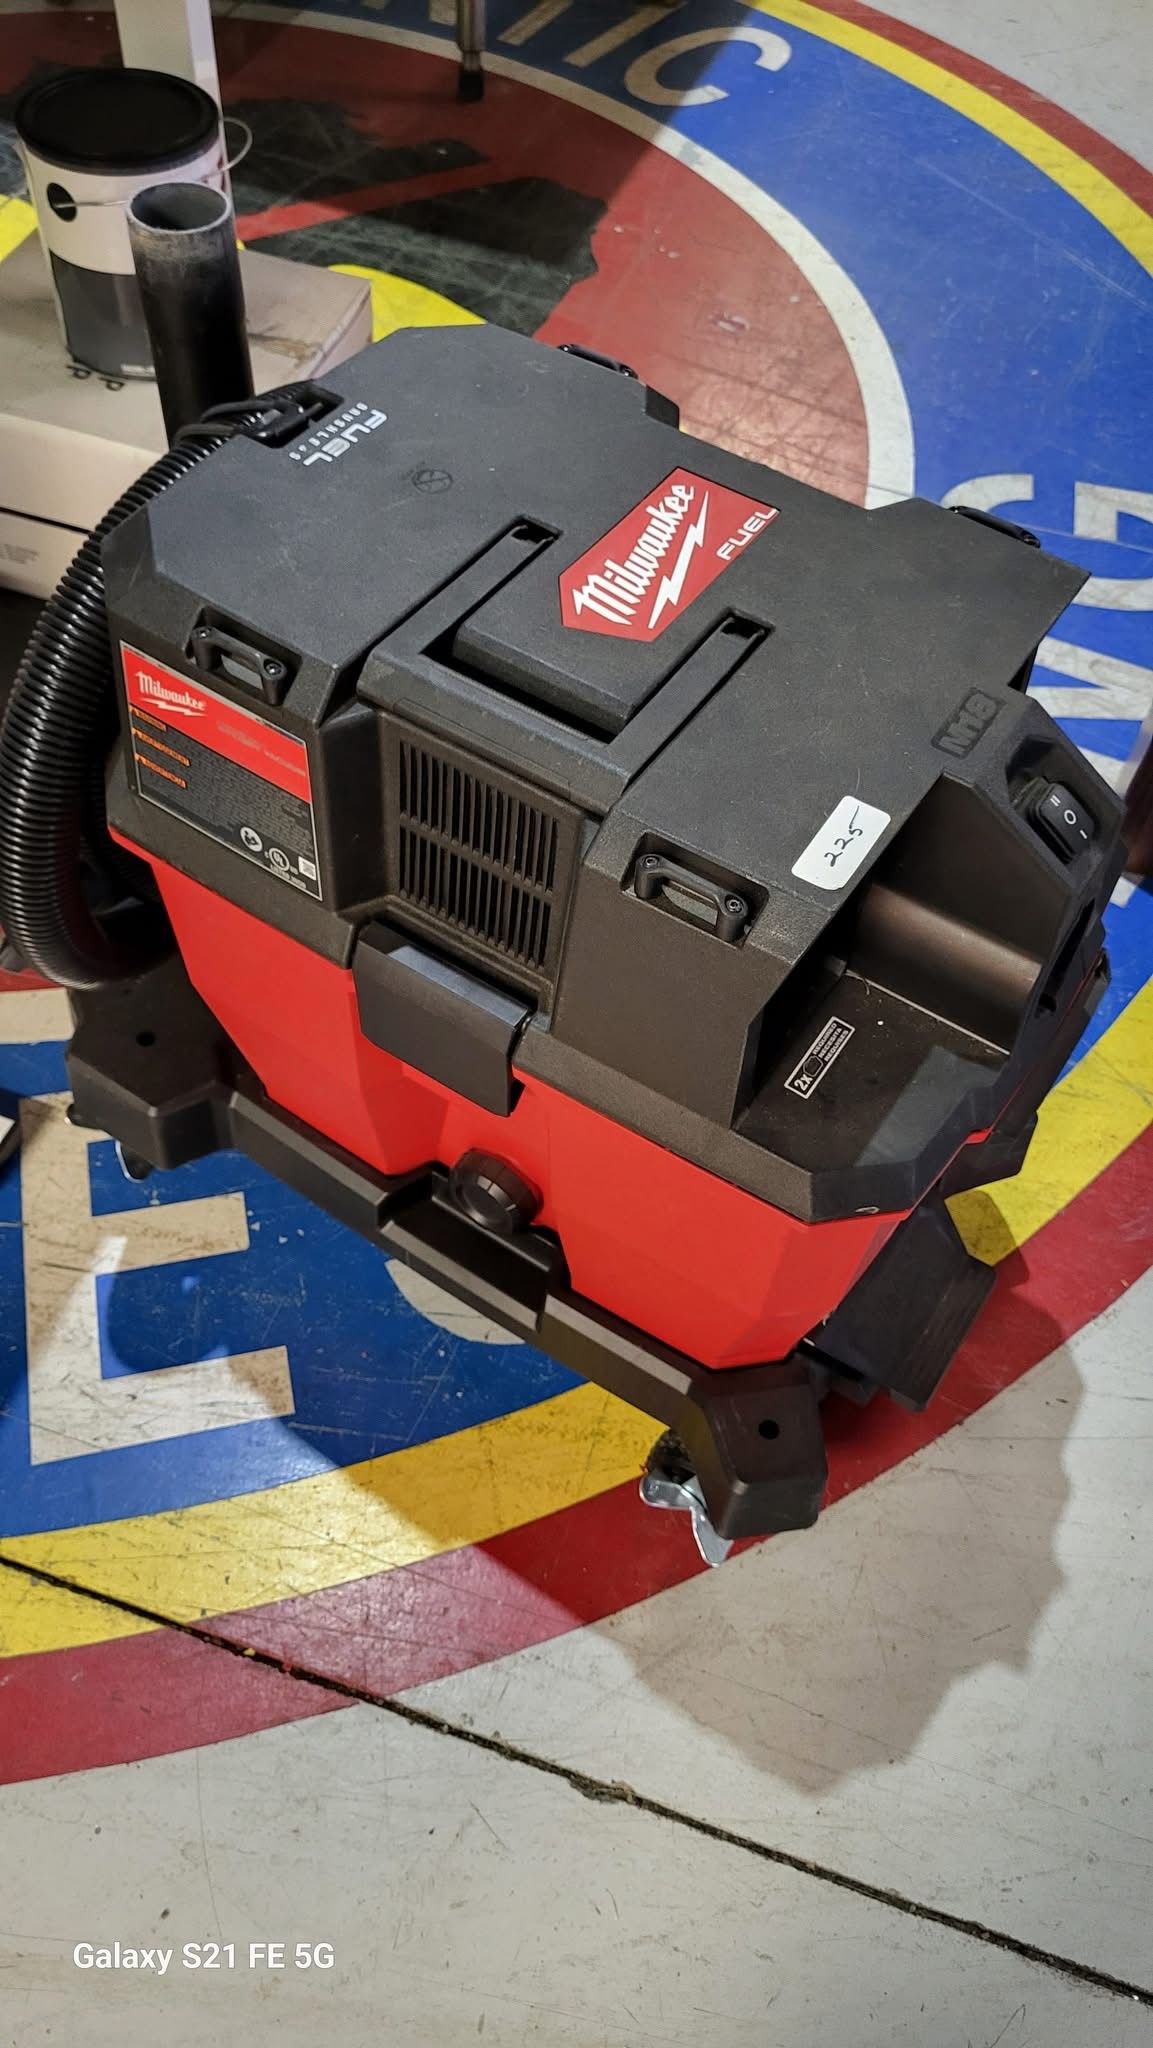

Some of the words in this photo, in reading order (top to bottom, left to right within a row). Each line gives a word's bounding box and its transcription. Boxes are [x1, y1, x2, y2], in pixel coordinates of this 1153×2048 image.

[303, 409, 387, 466] FUEL
[572, 485, 694, 625] Milwaukee
[716, 507, 779, 560] FUEL
[136, 671, 207, 712] Milwaukee
[936, 696, 993, 758] M18
[823, 805, 863, 868] 225
